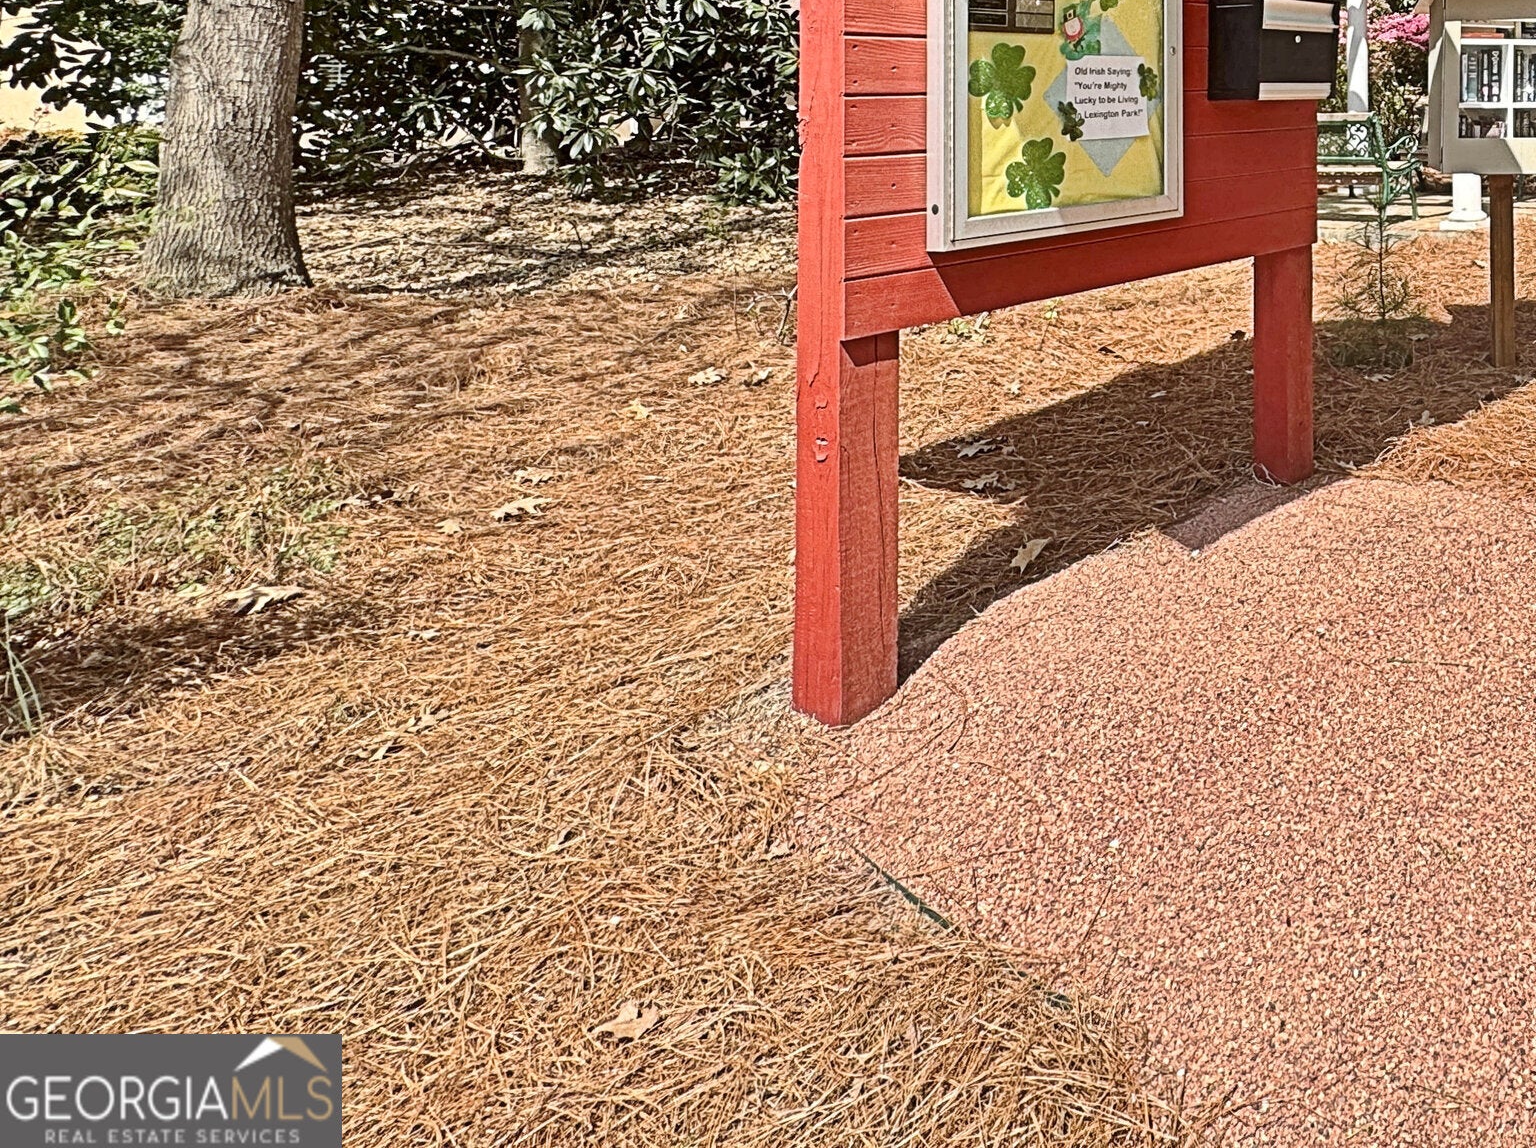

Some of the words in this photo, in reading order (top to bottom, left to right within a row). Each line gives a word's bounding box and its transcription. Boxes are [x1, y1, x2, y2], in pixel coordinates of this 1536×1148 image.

[1074, 67, 1087, 75] Old
[1089, 67, 1105, 75] Irish
[1104, 82, 1127, 91] Mighty
[1074, 96, 1096, 106] Lucky
[1098, 96, 1106, 104] to
[1107, 96, 1116, 104] be
[1117, 95, 1139, 105] Living
[1084, 110, 1119, 119] Lexington
